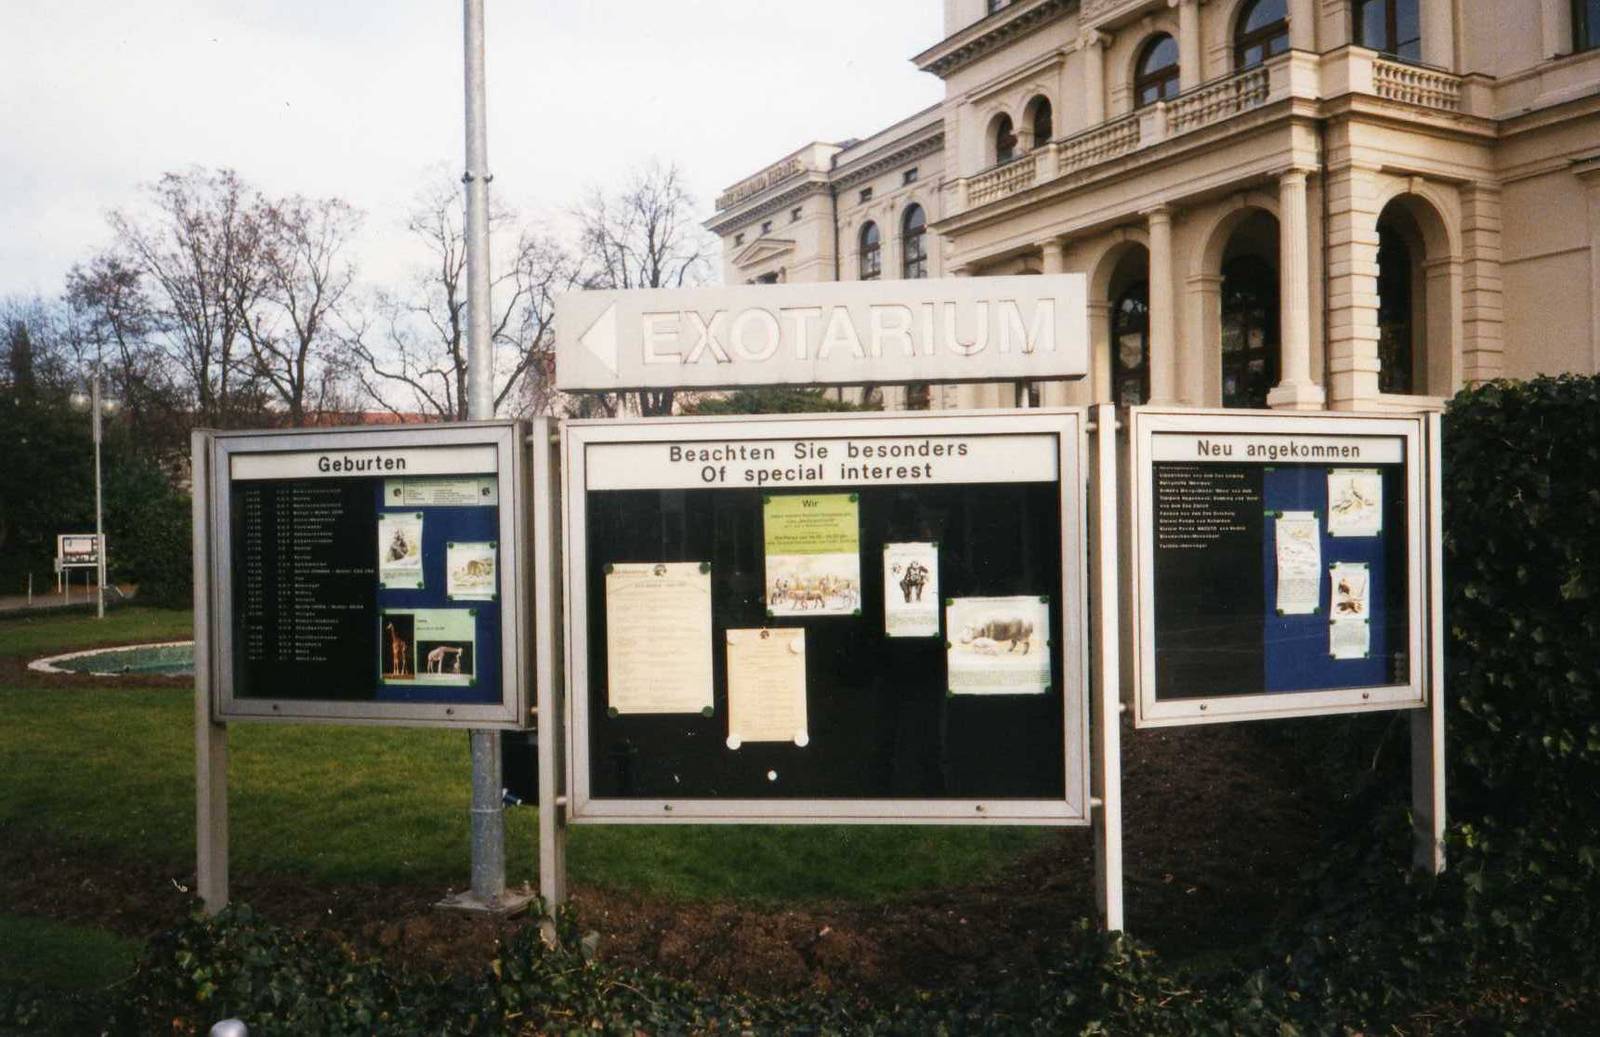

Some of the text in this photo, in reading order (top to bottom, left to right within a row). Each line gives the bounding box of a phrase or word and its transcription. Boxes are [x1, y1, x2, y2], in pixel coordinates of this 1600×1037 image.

[642, 298, 1056, 365] EXOTARIUM
[669, 440, 968, 462] Beachten Sie besonders
[1197, 440, 1361, 460] Neu angekommen
[318, 455, 406, 472] Geburten
[701, 463, 933, 485] Of special interest
[802, 499, 819, 508] Wir
